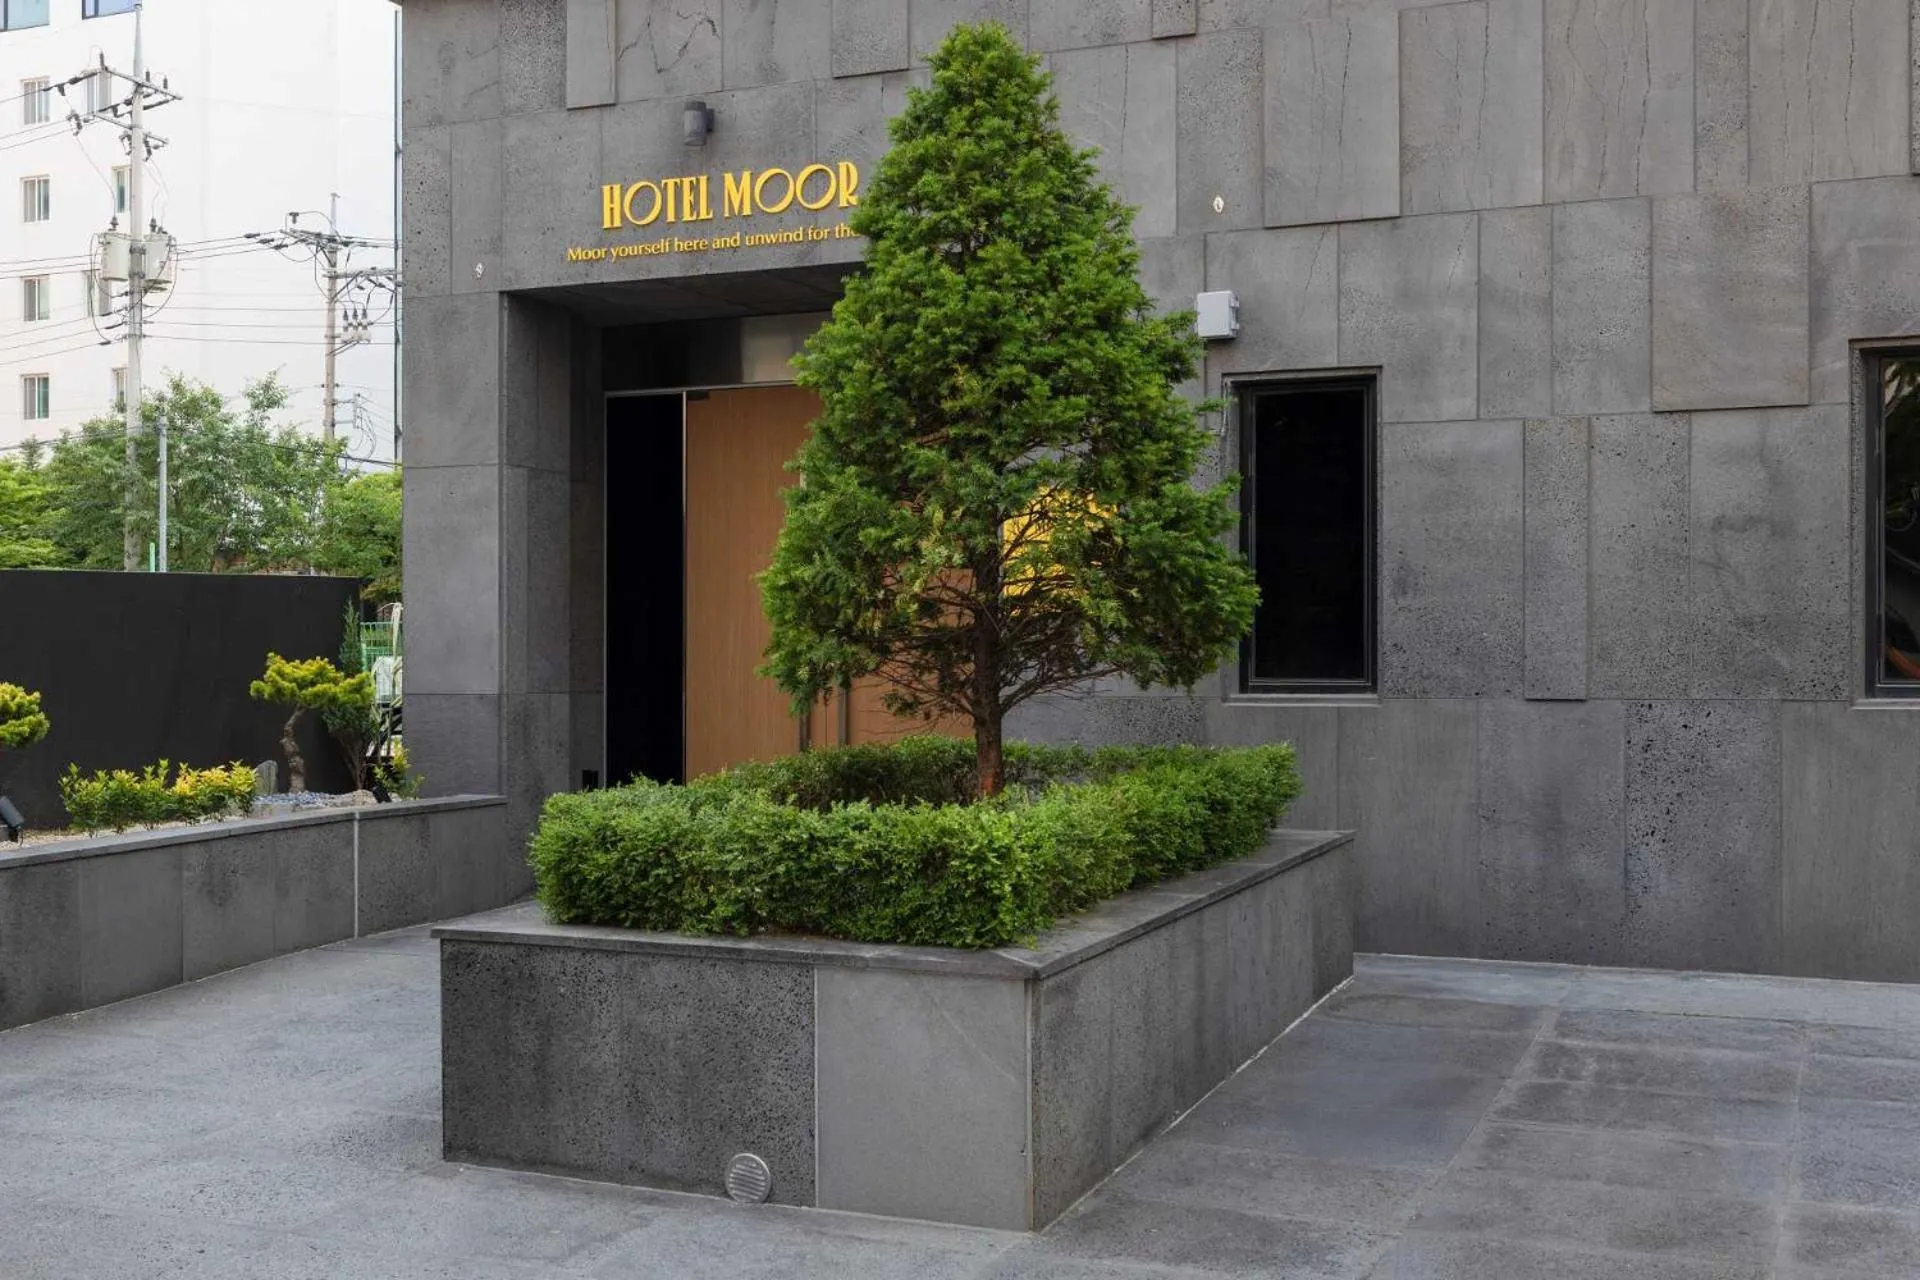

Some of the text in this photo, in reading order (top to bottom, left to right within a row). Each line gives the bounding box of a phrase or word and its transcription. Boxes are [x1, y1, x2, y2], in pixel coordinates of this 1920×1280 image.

[602, 161, 859, 229] HOTEL MOOR
[567, 246, 606, 262] Moor
[611, 238, 671, 262] yourself
[674, 236, 708, 253] here
[711, 232, 740, 249] and
[745, 226, 803, 246] unwind
[808, 223, 831, 240] for
